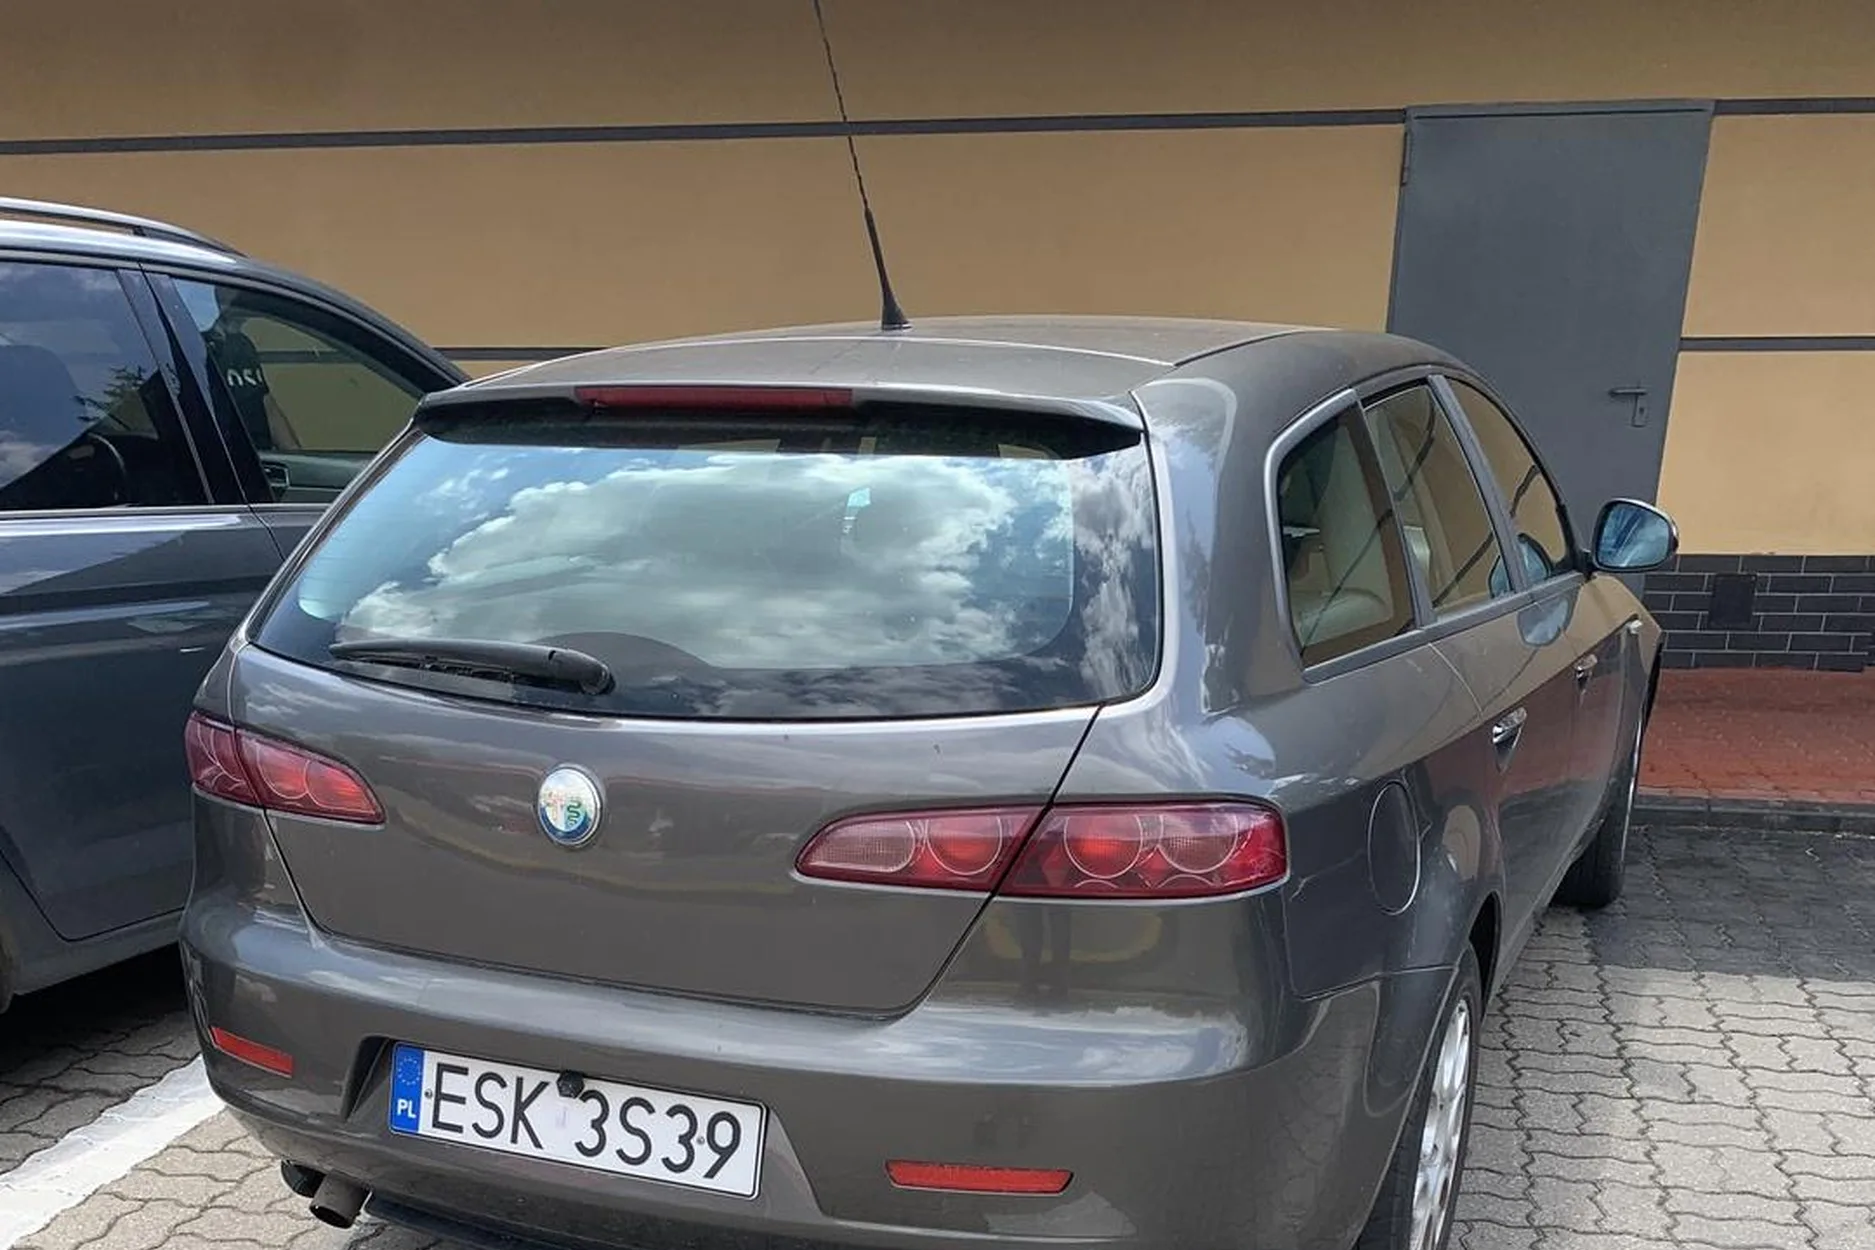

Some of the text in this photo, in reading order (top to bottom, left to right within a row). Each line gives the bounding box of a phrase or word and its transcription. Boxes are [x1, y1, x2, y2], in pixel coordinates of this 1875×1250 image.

[397, 1098, 417, 1118] PL
[432, 1062, 741, 1179] ESK 3S39
